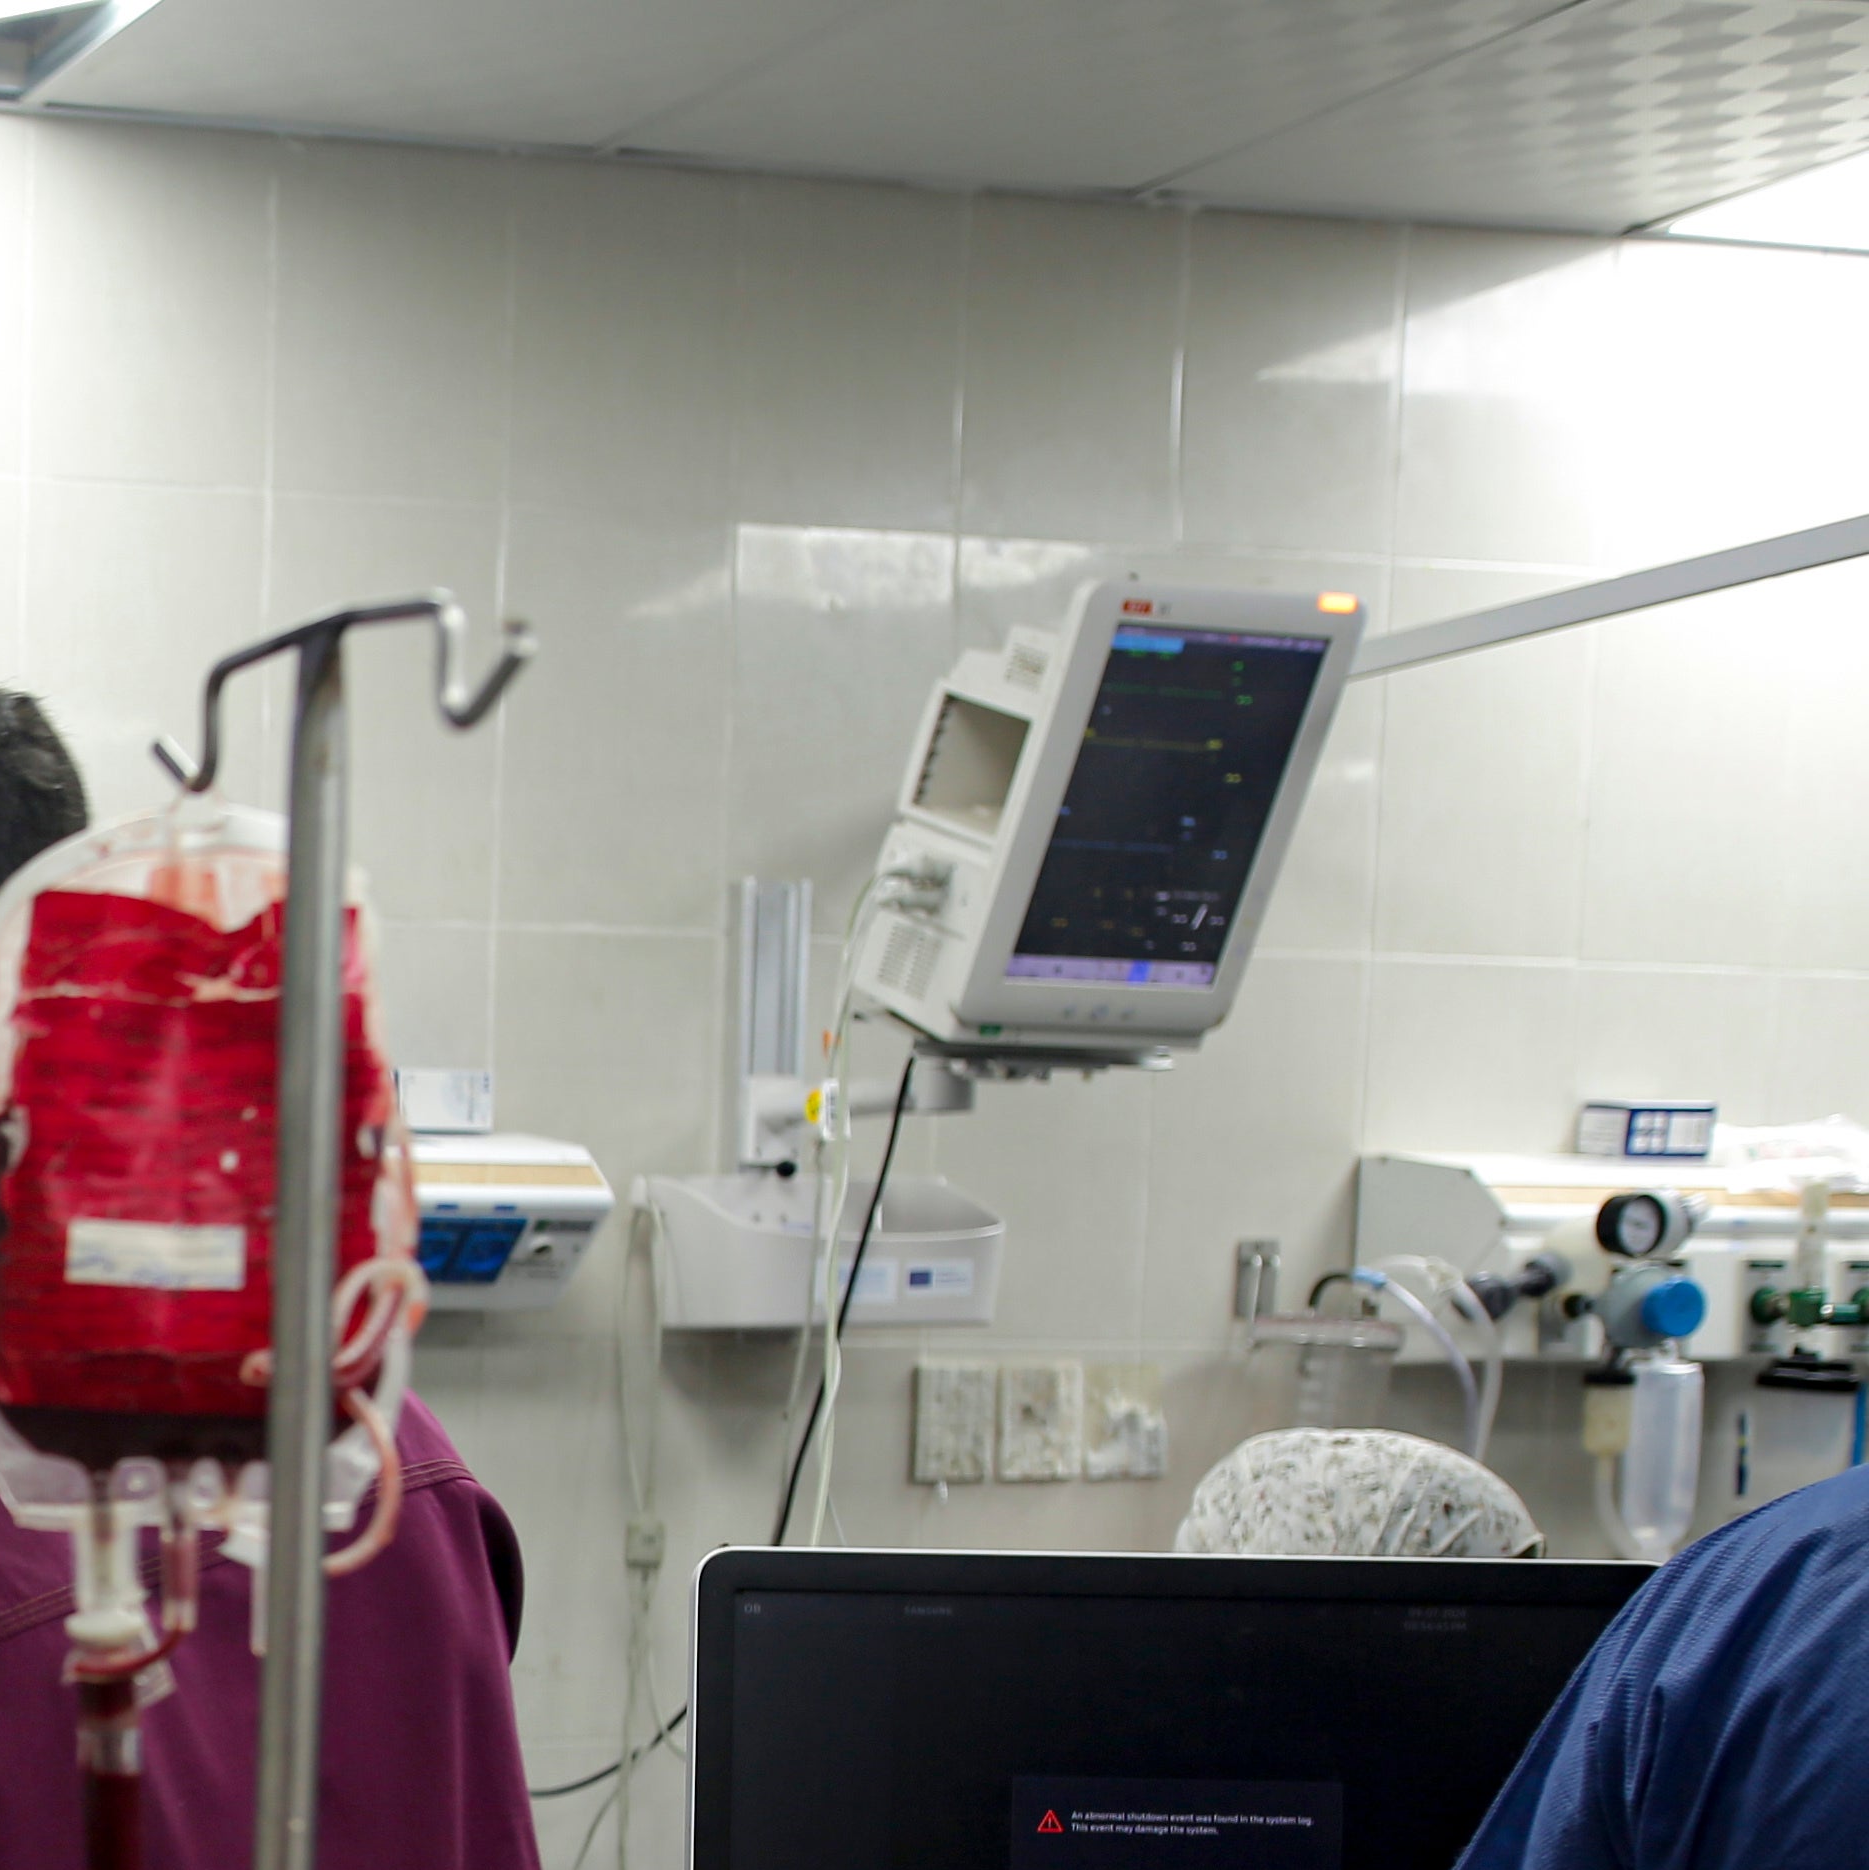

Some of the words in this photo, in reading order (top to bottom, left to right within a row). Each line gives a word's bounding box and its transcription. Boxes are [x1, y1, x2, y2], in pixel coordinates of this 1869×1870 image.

[1071, 1811, 1083, 1820] An
[1084, 1812, 1125, 1822] abnormal
[1127, 1813, 1167, 1823] shutdown
[1170, 1815, 1195, 1823] event
[1214, 1815, 1238, 1824] found
[1240, 1816, 1249, 1824] in
[1250, 1816, 1264, 1825] the
[1266, 1816, 1297, 1827] system
[1071, 1823, 1088, 1832] This
[1090, 1824, 1114, 1832] event
[1116, 1825, 1133, 1835] may
[1134, 1825, 1169, 1836] damage
[1170, 1826, 1185, 1834] the
